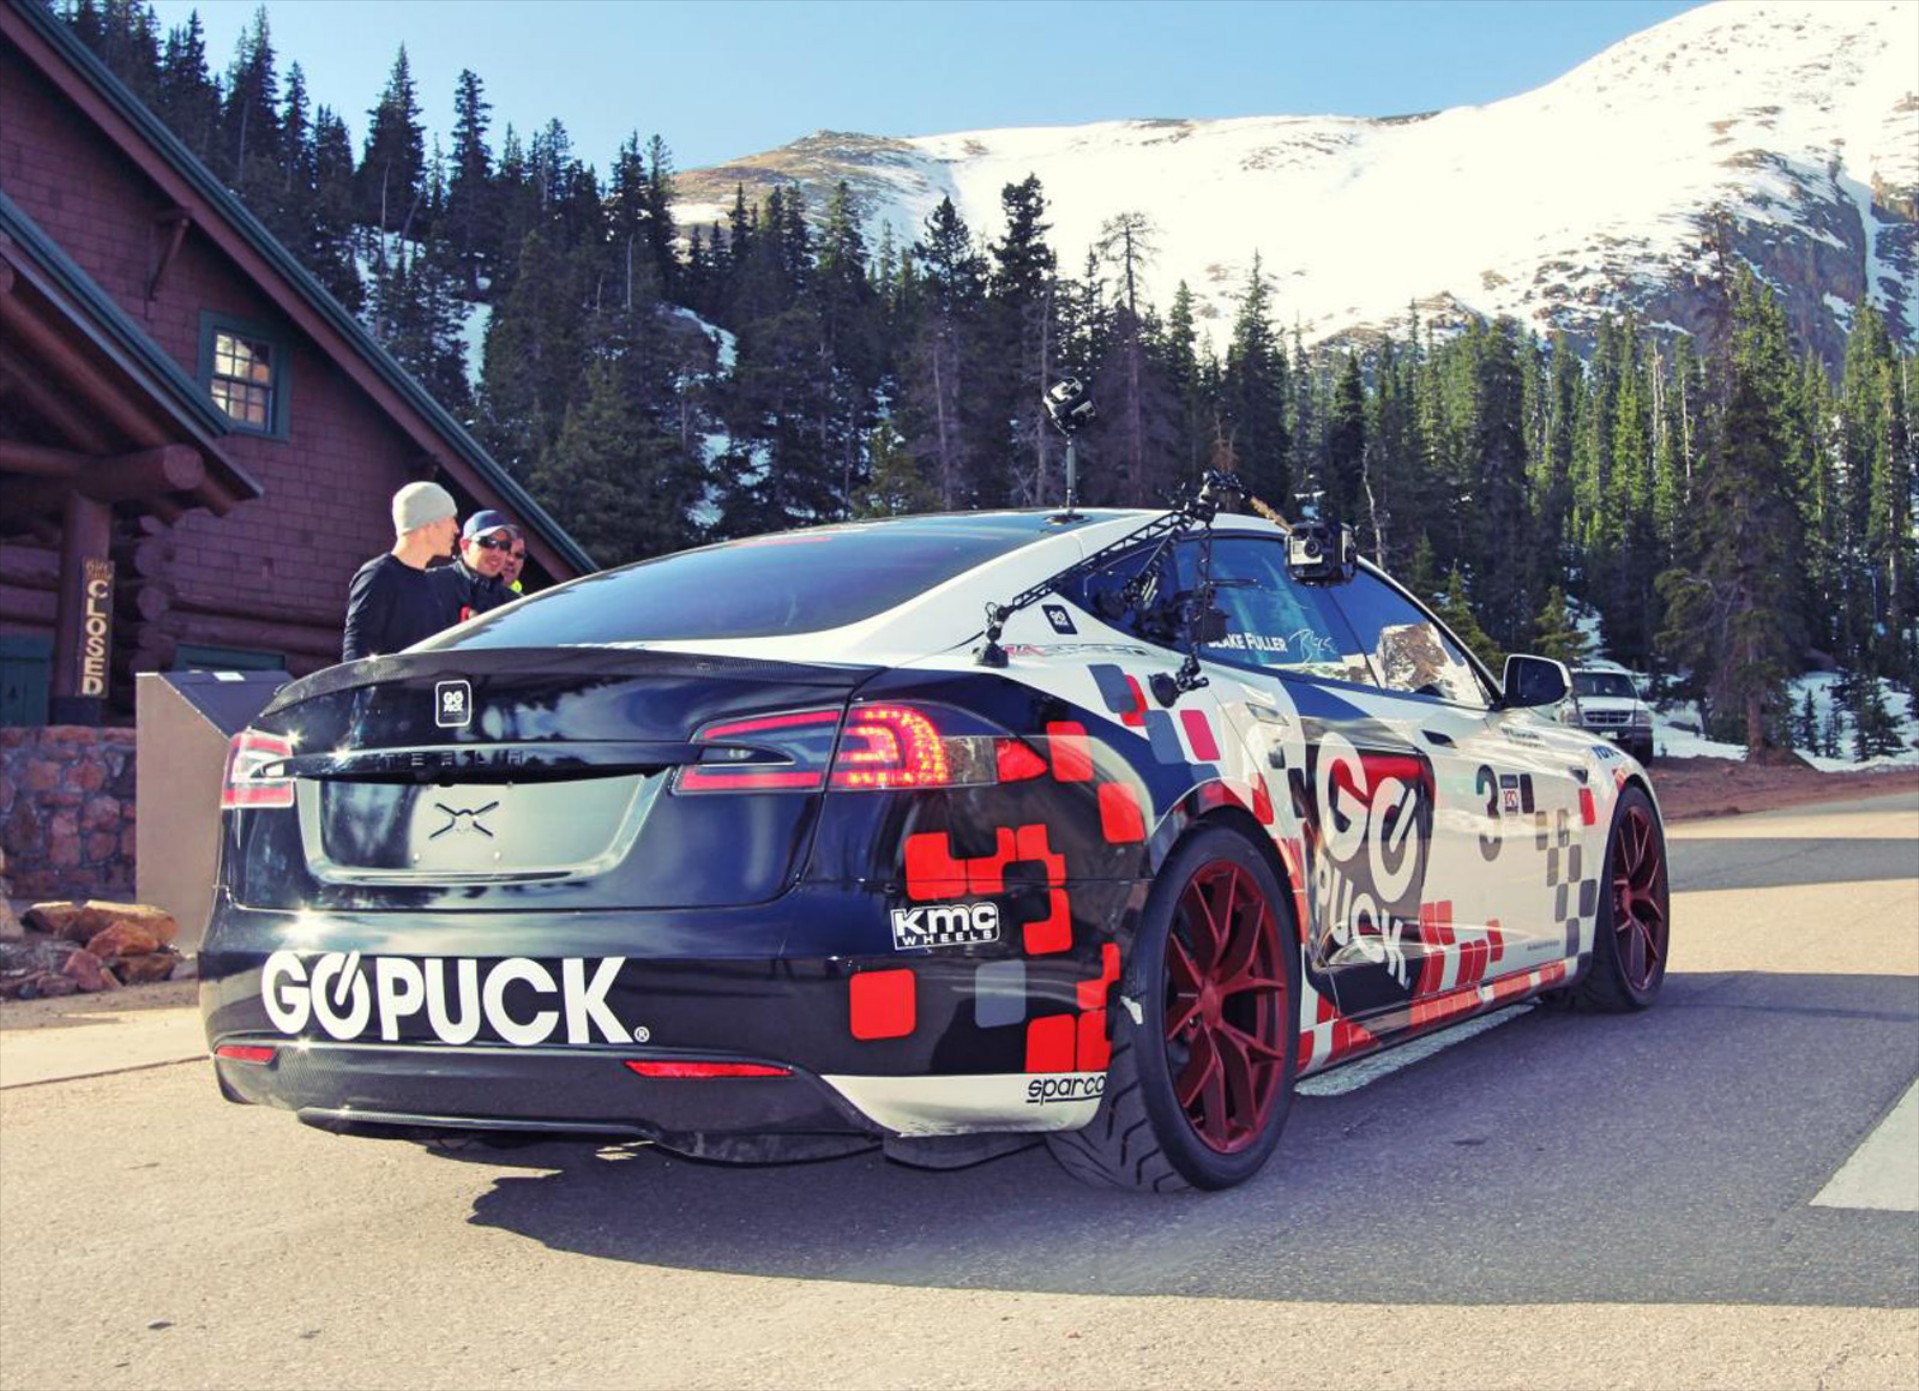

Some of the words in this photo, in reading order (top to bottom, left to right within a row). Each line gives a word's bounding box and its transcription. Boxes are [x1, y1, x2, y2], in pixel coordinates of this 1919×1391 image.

[82, 579, 108, 695] CLOSED
[1243, 632, 1288, 652] FULLER
[1476, 764, 1503, 862] 3
[901, 929, 993, 946] WHEELS
[1317, 852, 1408, 987] PUCK
[1026, 1074, 1107, 1106] sparco
